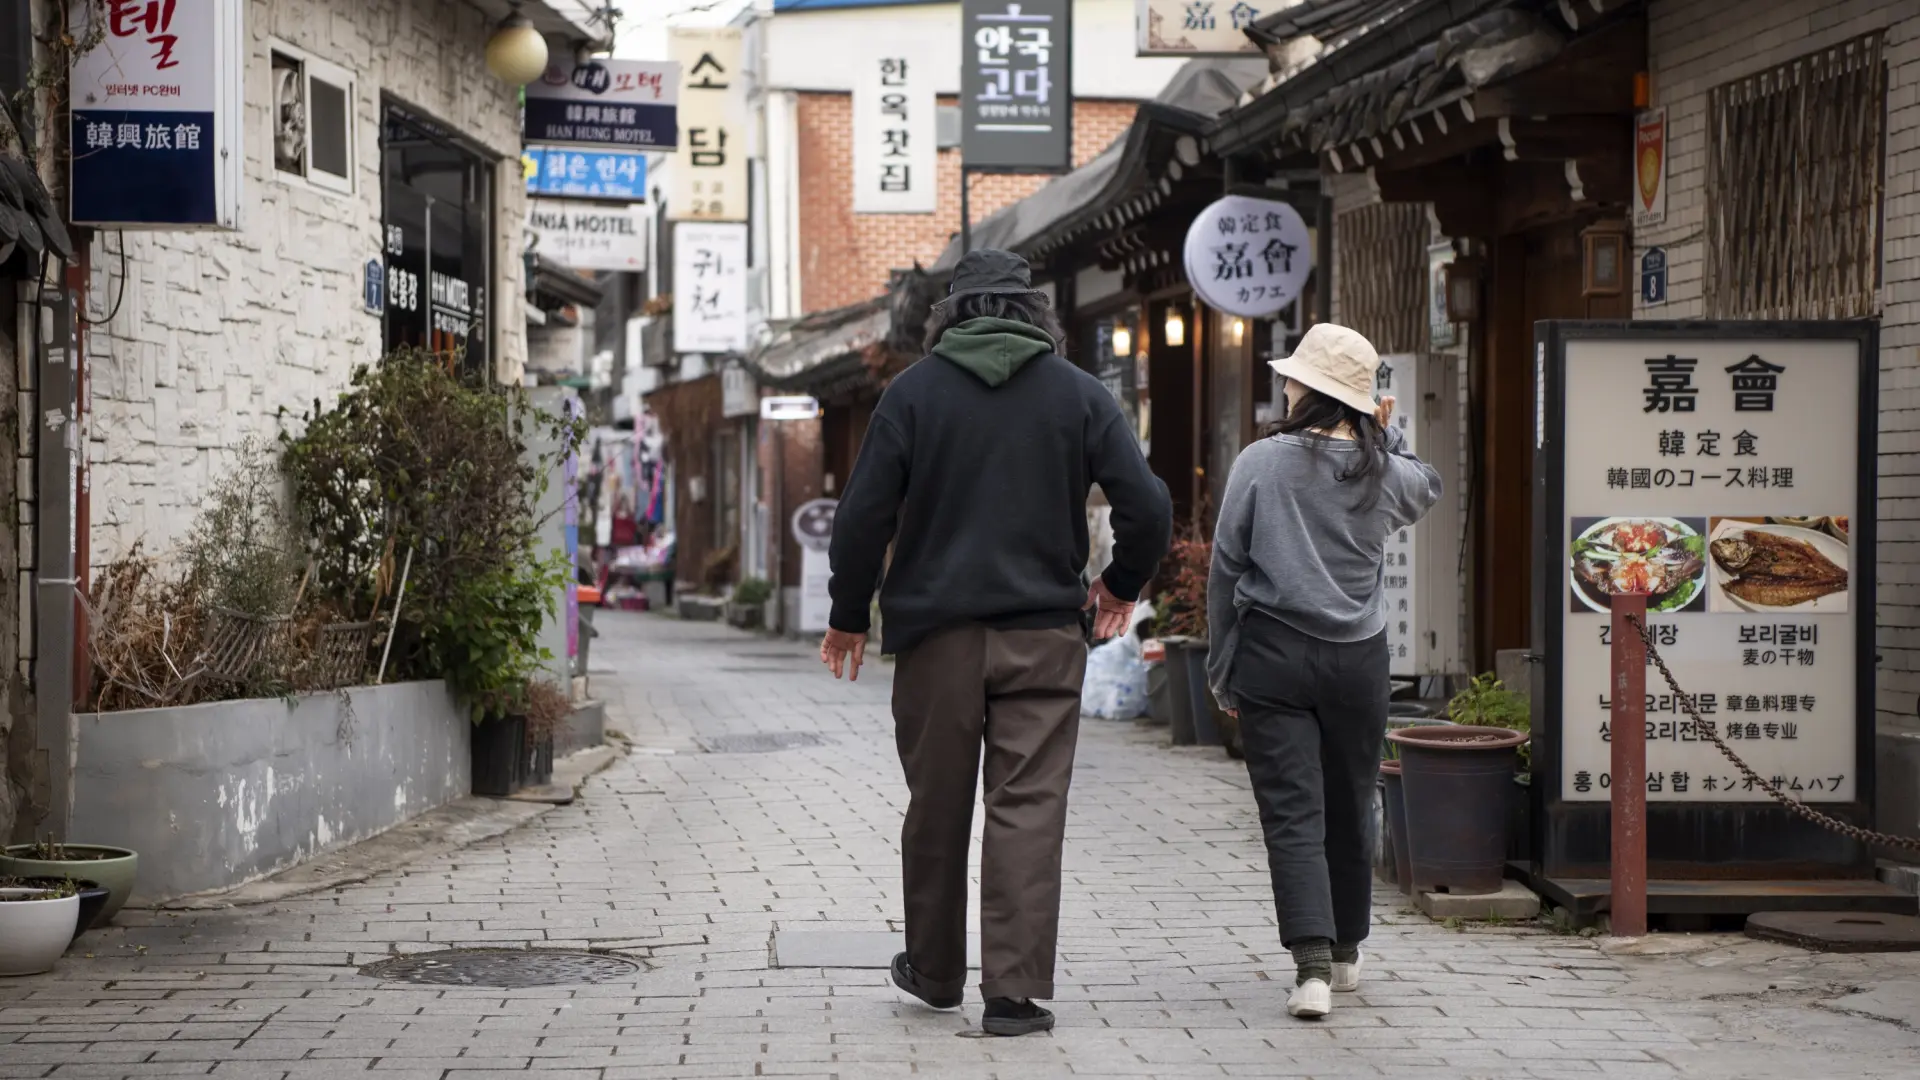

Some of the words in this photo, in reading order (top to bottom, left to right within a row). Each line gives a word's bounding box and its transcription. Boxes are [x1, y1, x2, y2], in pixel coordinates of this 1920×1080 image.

[975, 26, 1052, 64] 안국
[106, 85, 139, 96] 인터넷
[143, 84, 181, 96] PC완비
[613, 72, 663, 98] 모텔
[976, 66, 1052, 103] 고다
[687, 52, 729, 167] 소담
[86, 122, 201, 149] 韓興旅館
[546, 124, 573, 138] HAN
[575, 126, 611, 140] HUNG
[613, 128, 655, 143] MOTEL
[574, 214, 636, 236] HOSTEL
[1219, 212, 1281, 234] 韓定食
[1210, 238, 1298, 280] 嘉會
[1237, 286, 1286, 303] カフェ
[1650, 275, 1657, 299] 8
[1642, 354, 1786, 413] 嘉會
[1658, 429, 1758, 457] 韓定食
[1607, 466, 1794, 490] 韓國のコース料理
[1738, 624, 1818, 645] 보리굴비
[1743, 648, 1815, 666] 麦の干物
[1726, 694, 1816, 712] 章鱼料理专
[1726, 722, 1798, 740] 烤鱼专业
